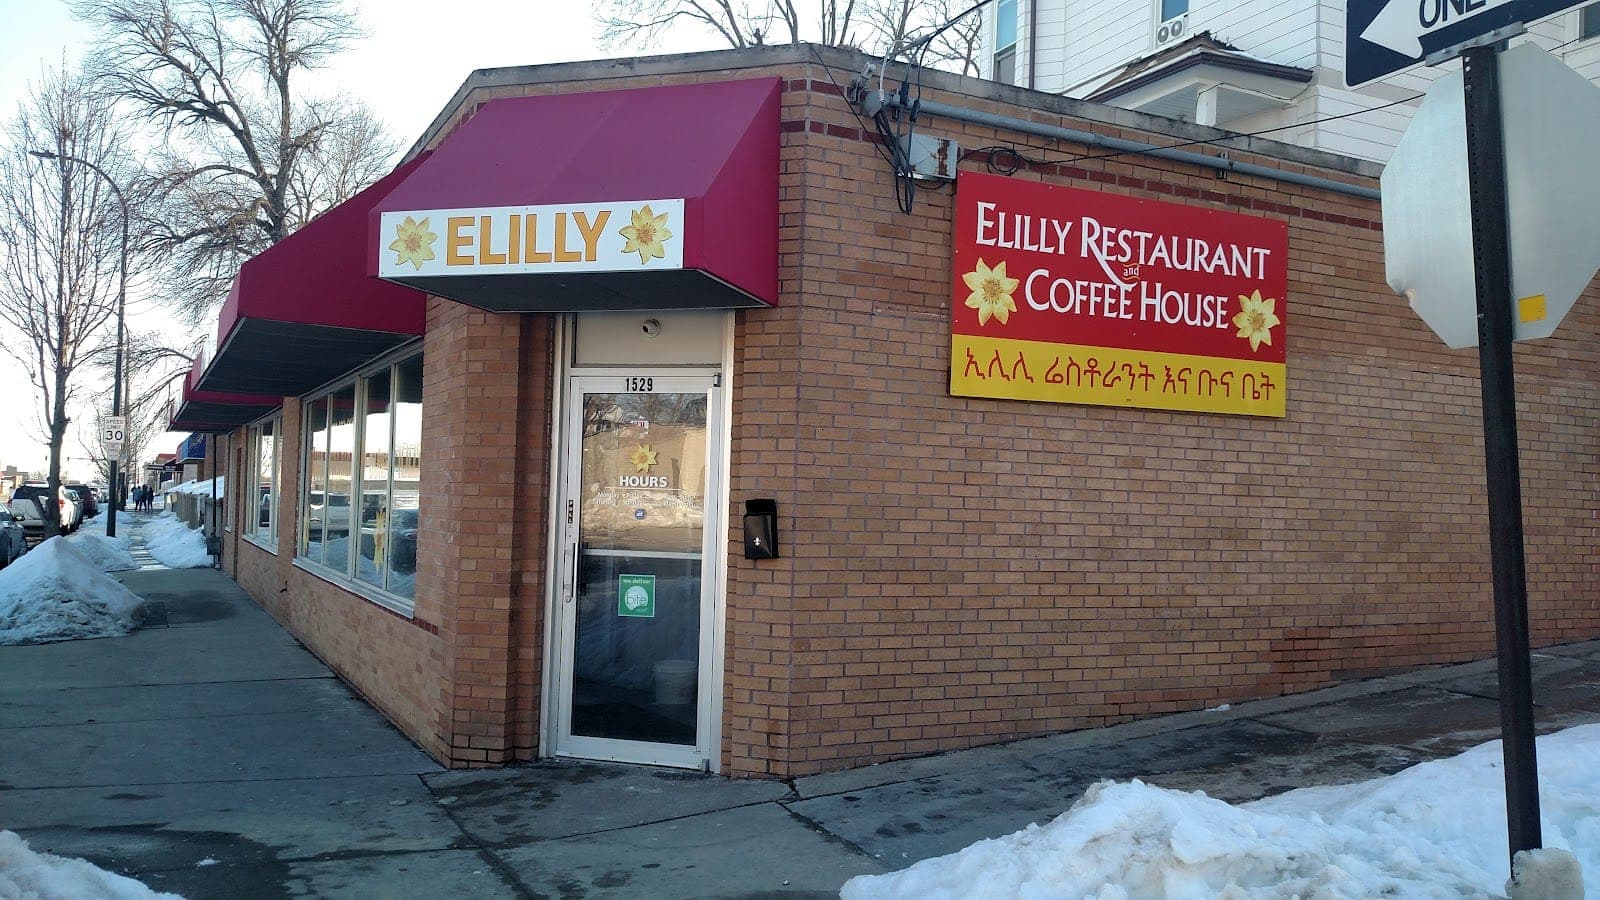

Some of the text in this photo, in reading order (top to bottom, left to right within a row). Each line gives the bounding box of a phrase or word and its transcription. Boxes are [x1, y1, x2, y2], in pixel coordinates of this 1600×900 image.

[446, 211, 612, 266] ELILLY
[976, 201, 1271, 287] ELILLY RESTAURANT
[1123, 264, 1140, 277] and
[1025, 269, 1230, 329] COFFEE HOUSE
[964, 347, 1276, 401] ኢሊሊ ሬስቶራንት እና ቡና ቤት
[625, 377, 654, 392] 1529
[105, 430, 123, 441] 30
[619, 475, 669, 489] HOURS
[627, 591, 647, 606] bite
